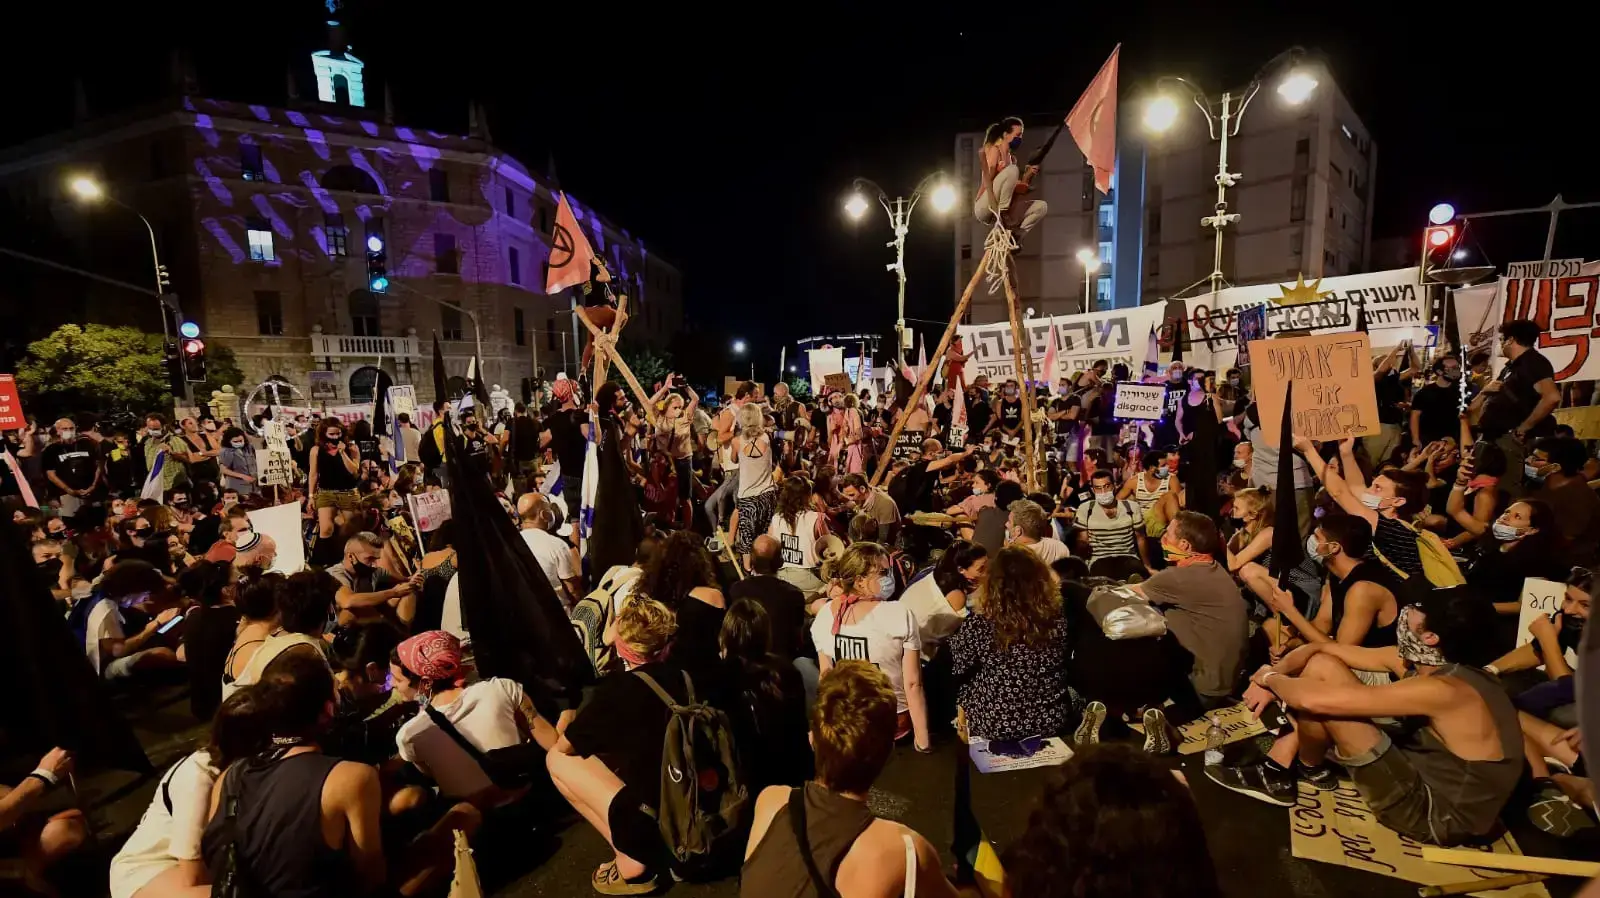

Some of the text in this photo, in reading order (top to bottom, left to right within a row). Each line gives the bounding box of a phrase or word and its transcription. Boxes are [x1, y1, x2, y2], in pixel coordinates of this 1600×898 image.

[1549, 260, 1581, 277] כולם
[1345, 284, 1416, 305] משנים
[1363, 307, 1419, 325] אזרחים
[1116, 402, 1159, 413] disgrace
[1296, 404, 1368, 437] באתי
[911, 431, 922, 444] לא
[781, 548, 802, 563] ישרא
